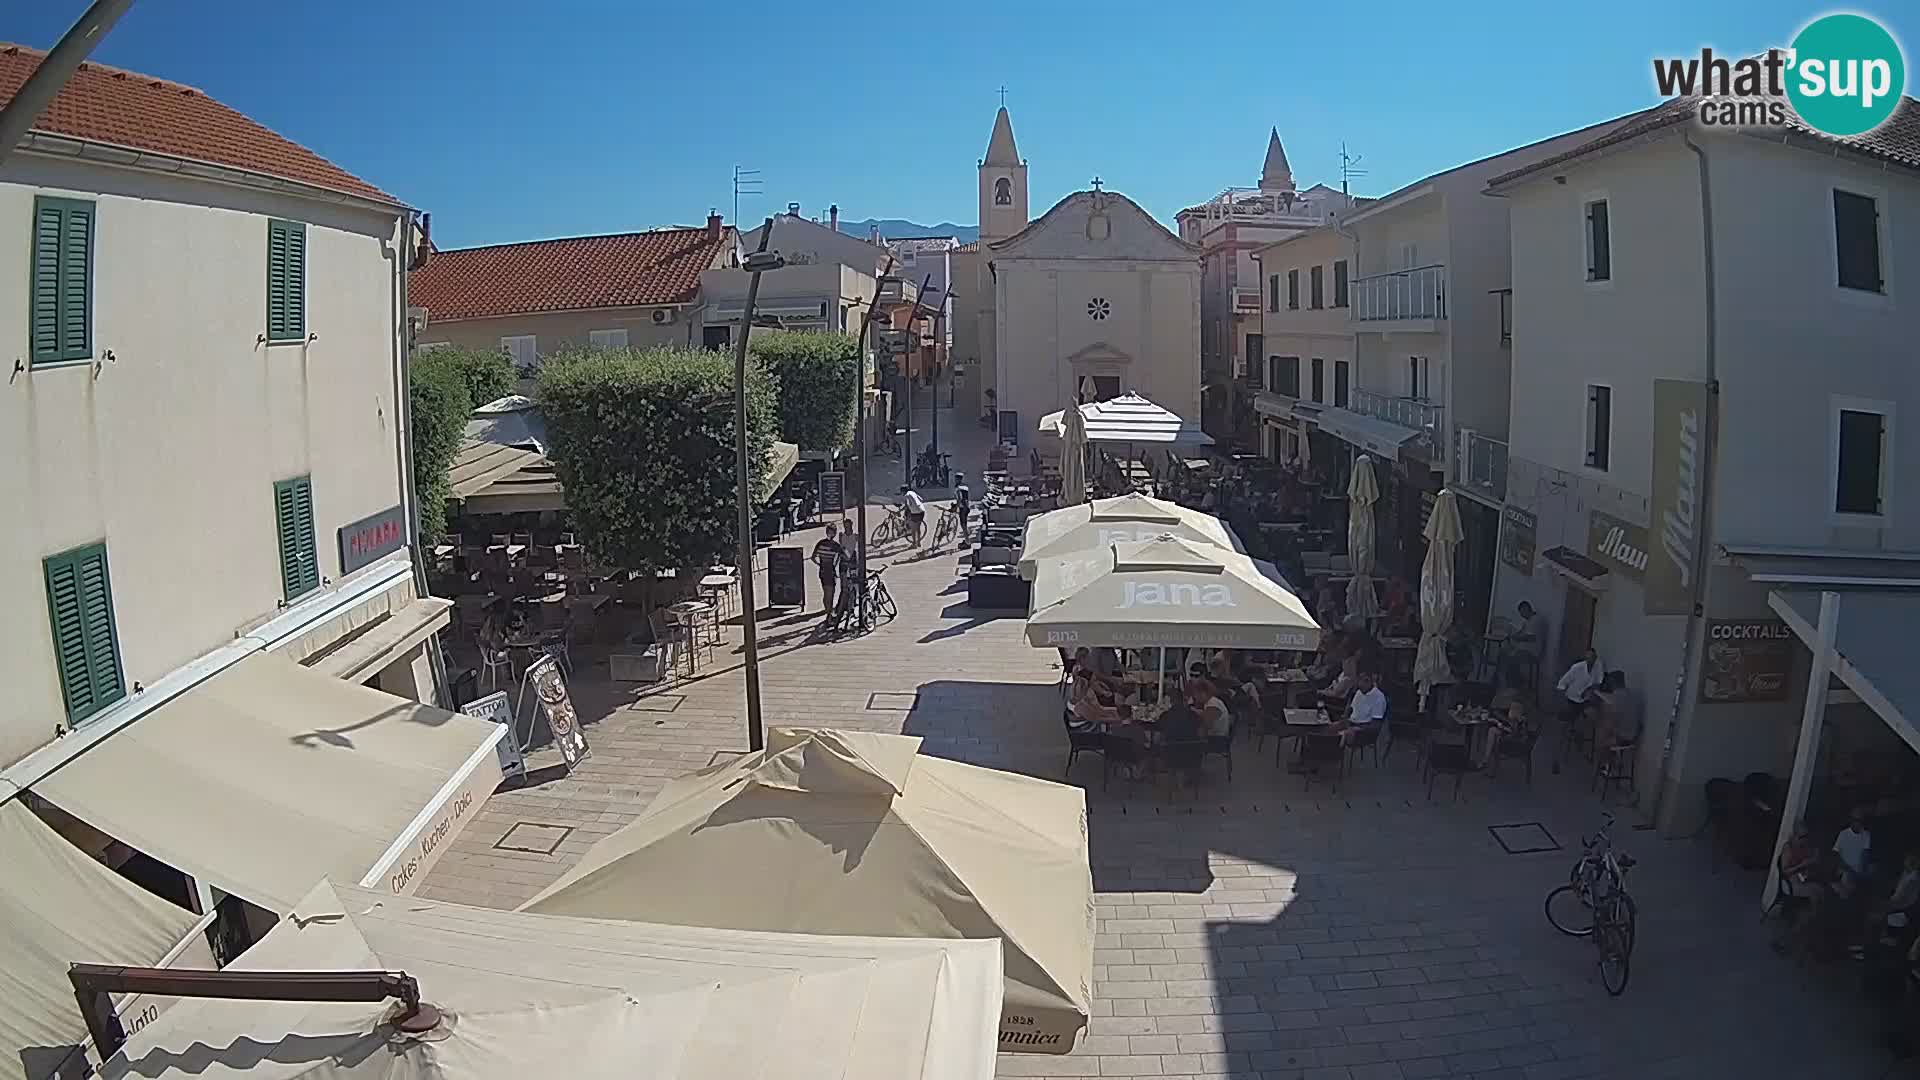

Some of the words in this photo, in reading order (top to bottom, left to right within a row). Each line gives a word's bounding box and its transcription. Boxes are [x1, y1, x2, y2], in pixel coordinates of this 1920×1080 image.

[1711, 624, 1791, 639] COCKTAILS
[469, 699, 505, 718] TATTOO
[391, 858, 417, 894] Cakes
[420, 817, 450, 858] Kuchen
[453, 791, 473, 819] Dolci
